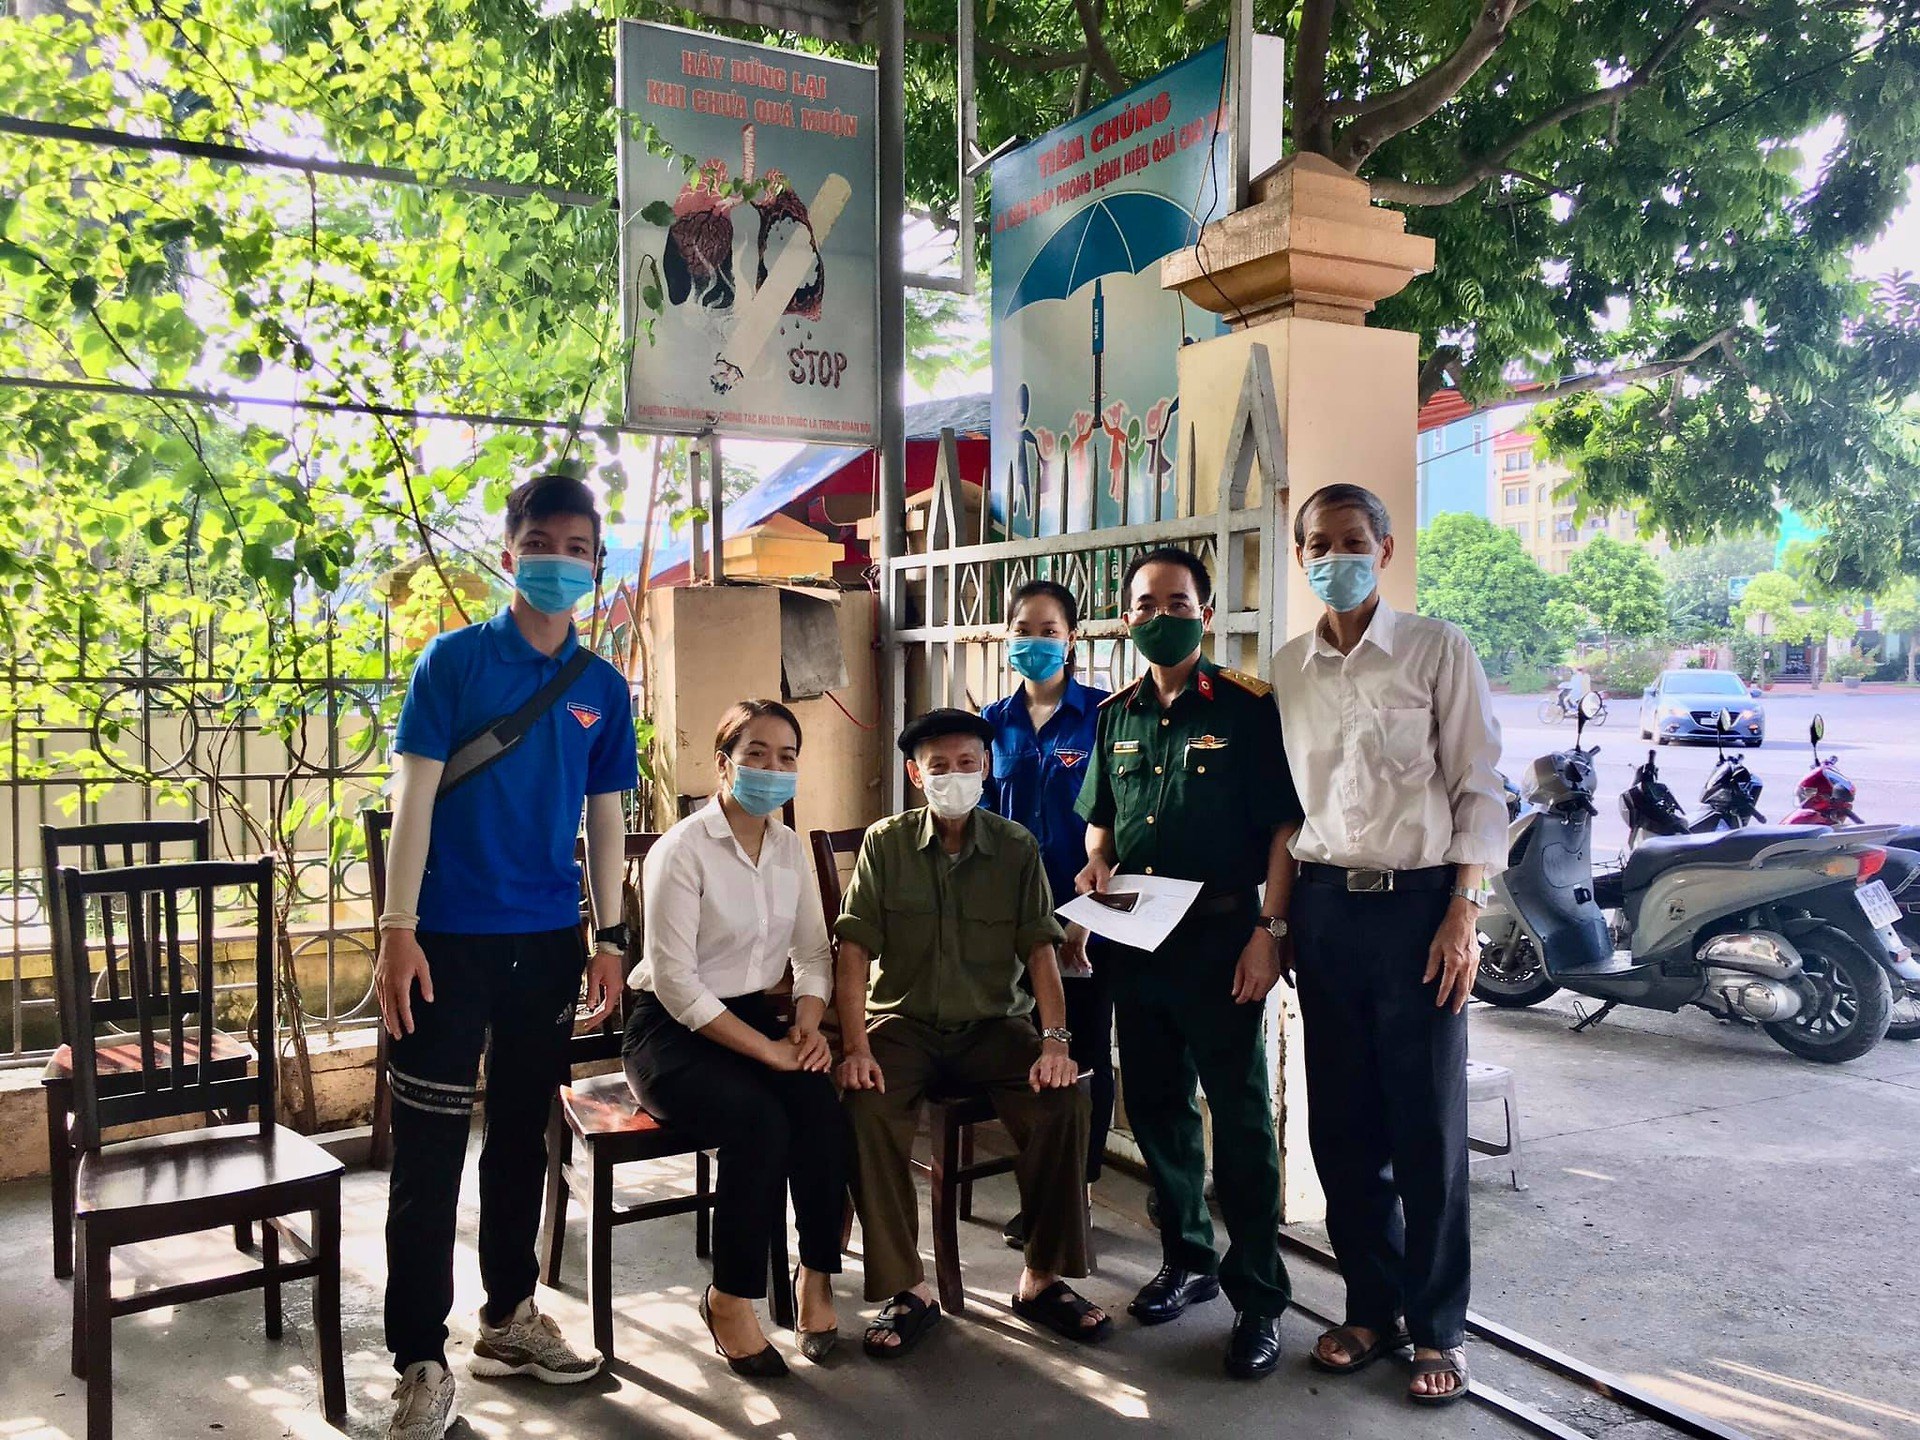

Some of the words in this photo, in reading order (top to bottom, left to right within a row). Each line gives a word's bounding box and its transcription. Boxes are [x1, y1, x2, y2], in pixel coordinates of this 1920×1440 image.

[681, 48, 725, 80] HÃY
[792, 71, 827, 103] LẠI
[646, 79, 687, 109] KHI
[692, 89, 749, 120] CHƯA
[754, 98, 796, 128] QUÁ
[800, 107, 858, 139] MUỘN
[787, 348, 848, 389] STOP
